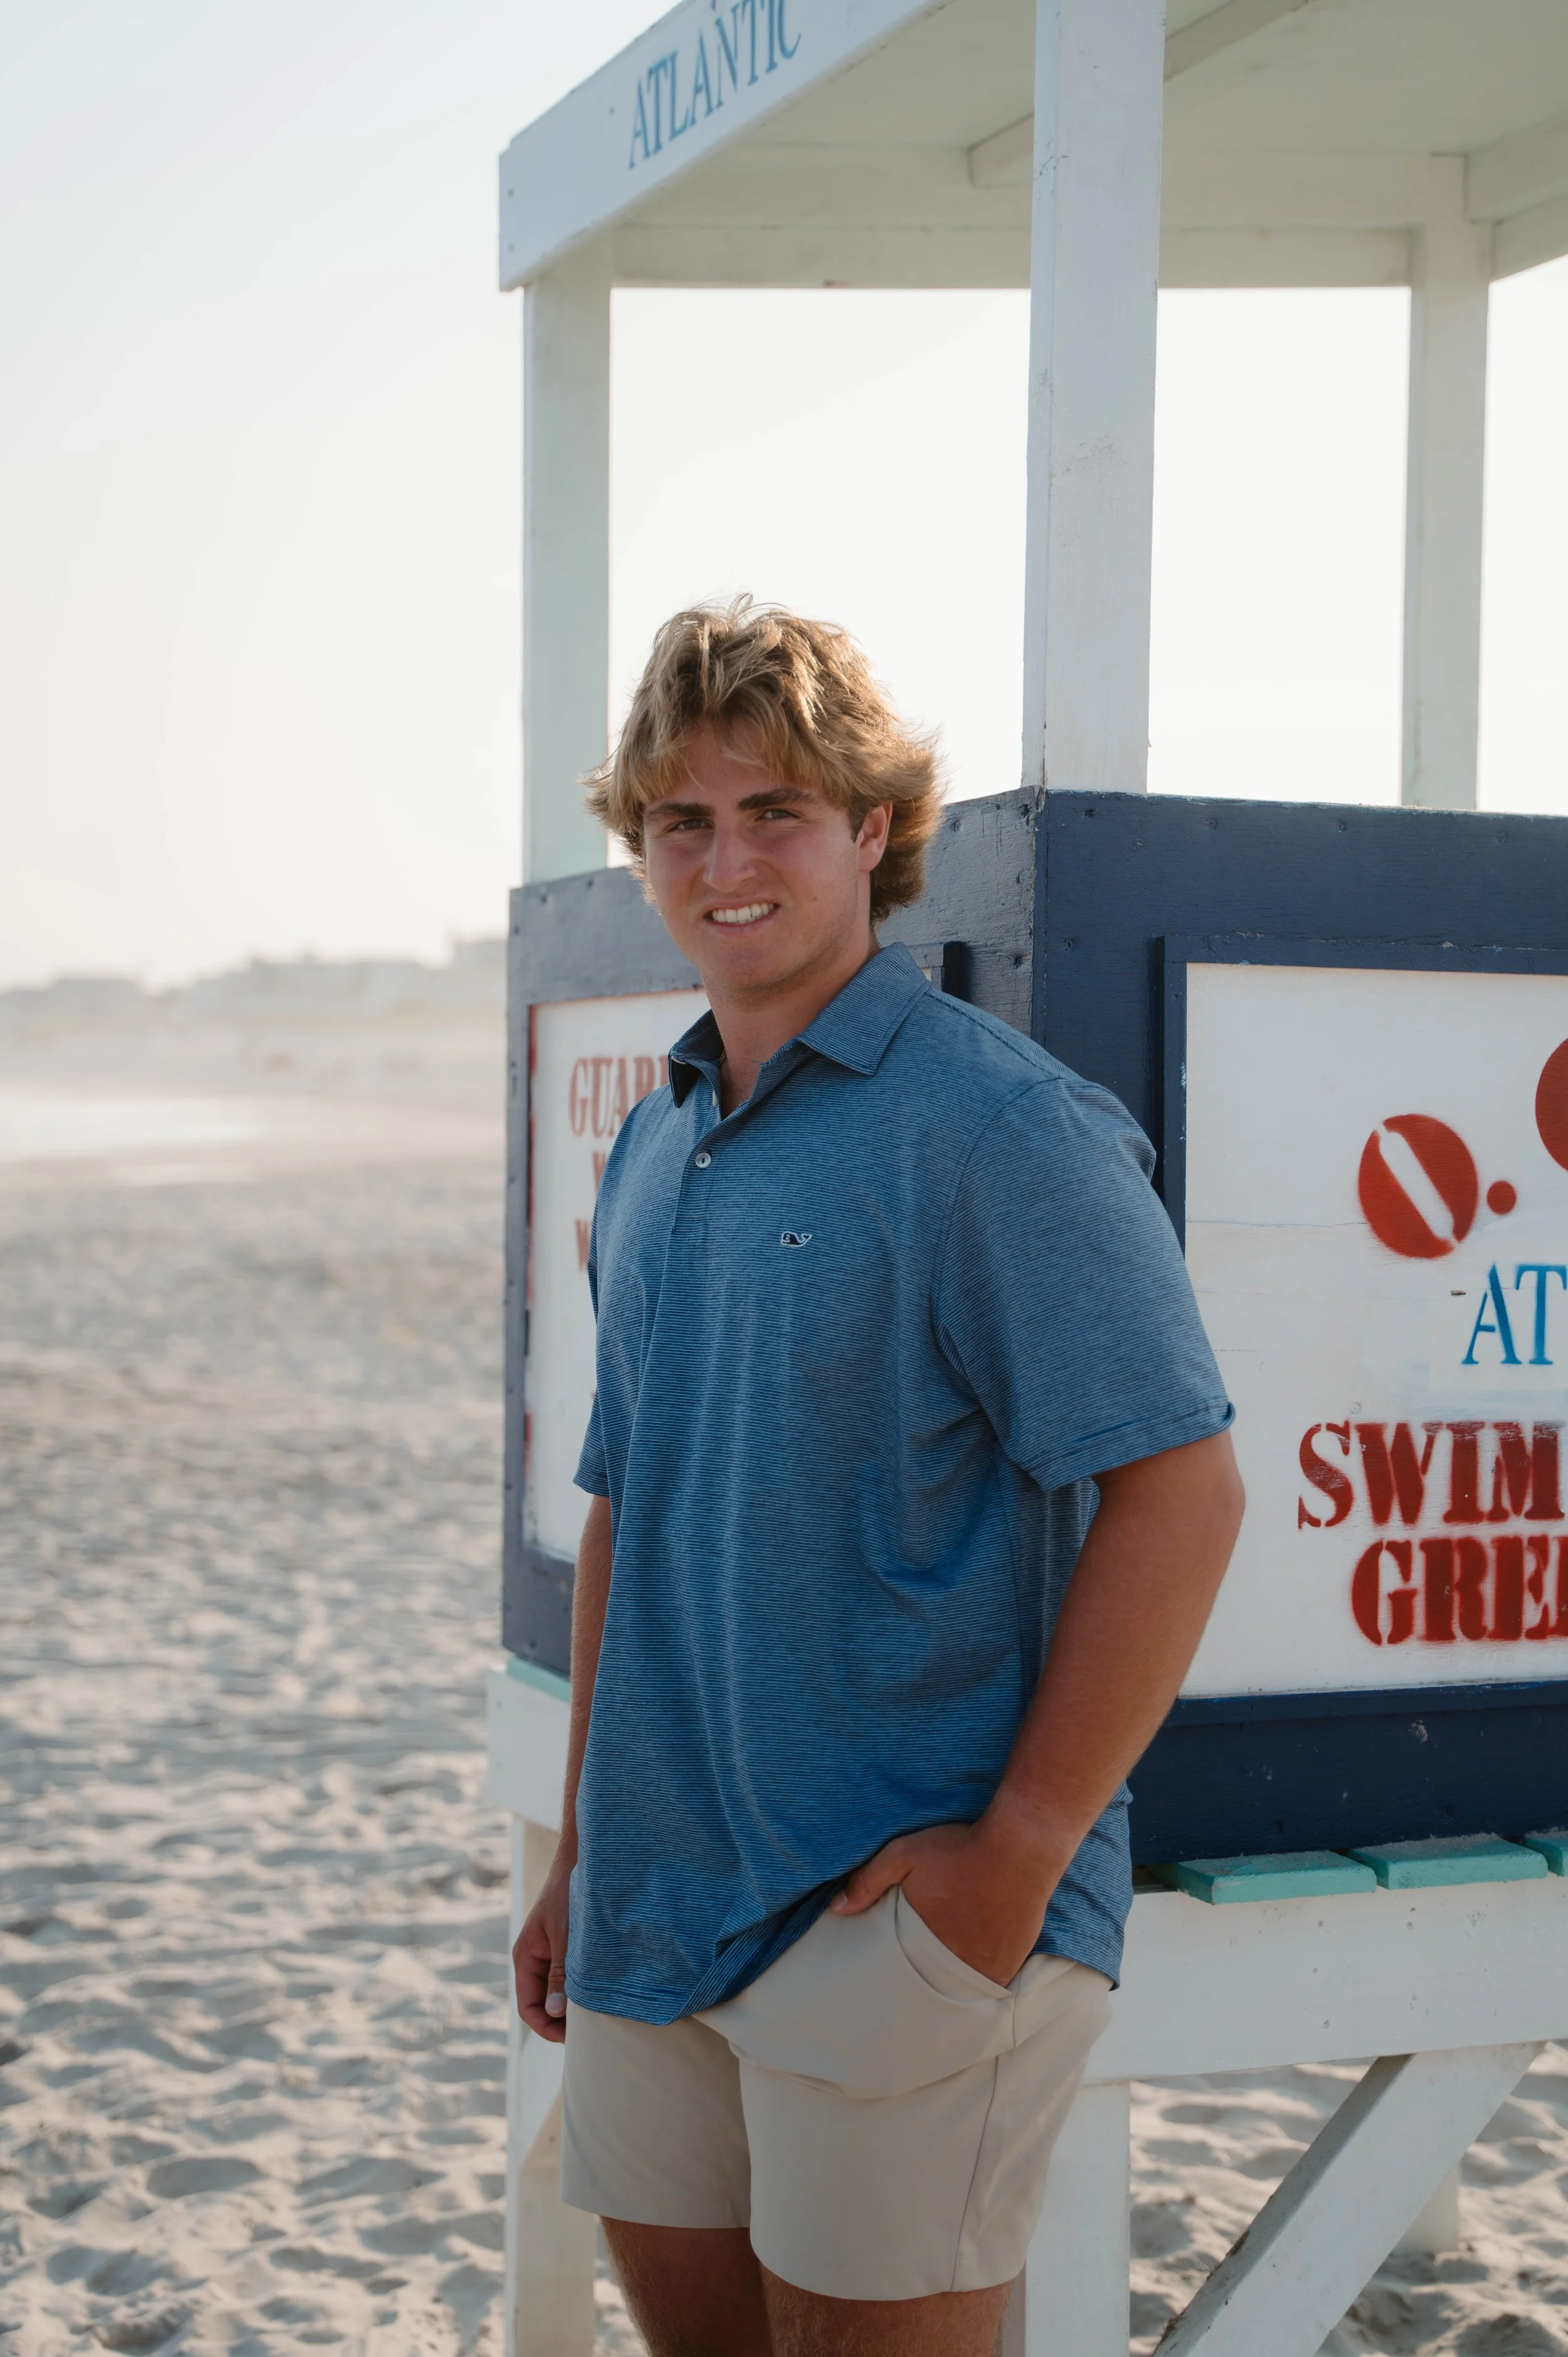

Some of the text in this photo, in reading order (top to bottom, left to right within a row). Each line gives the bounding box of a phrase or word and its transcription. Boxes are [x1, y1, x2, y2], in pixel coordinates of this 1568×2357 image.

[628, 0, 802, 170] ATLANTIC
[568, 1054, 669, 1138] GUAR
[1298, 1419, 1565, 1529] SWIM
[1350, 1533, 1568, 1646] GRE
